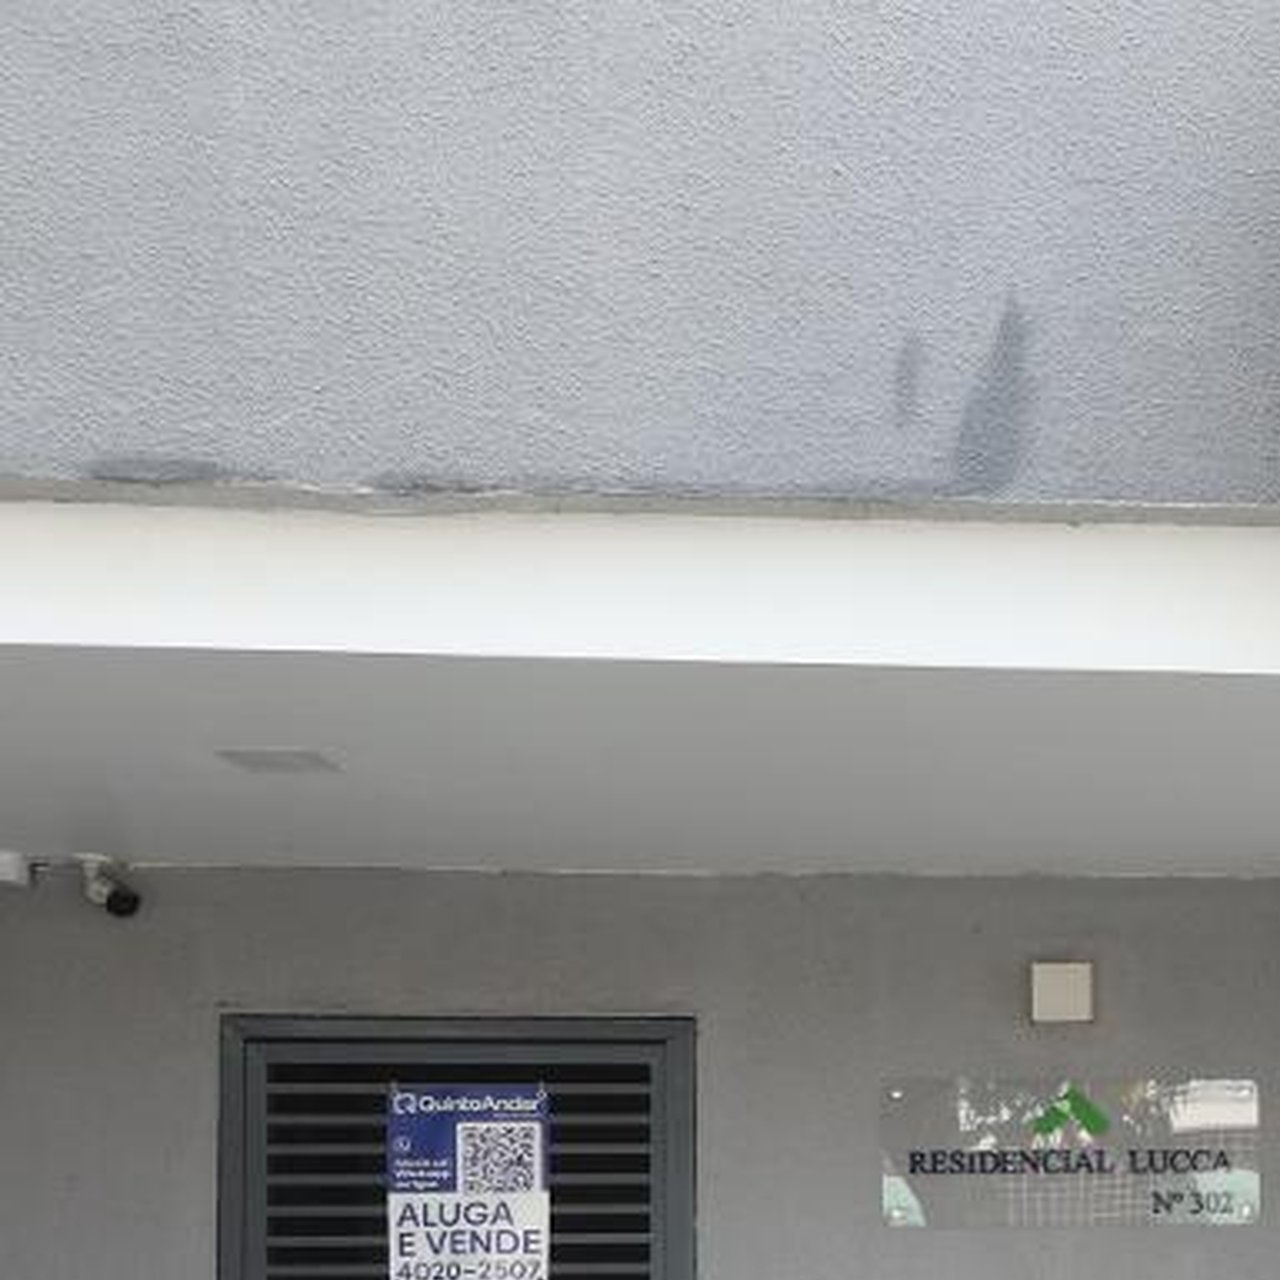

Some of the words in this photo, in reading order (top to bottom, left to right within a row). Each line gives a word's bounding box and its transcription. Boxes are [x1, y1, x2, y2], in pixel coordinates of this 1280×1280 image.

[419, 1095, 539, 1112] QuintoAndar
[908, 1148, 1116, 1176] RESIDENCIAL
[1129, 1148, 1232, 1175] LUCCA
[396, 1201, 515, 1228] ALUGA
[1190, 1191, 1234, 1215] 302
[398, 1232, 417, 1258] E
[426, 1229, 542, 1256] VENDE
